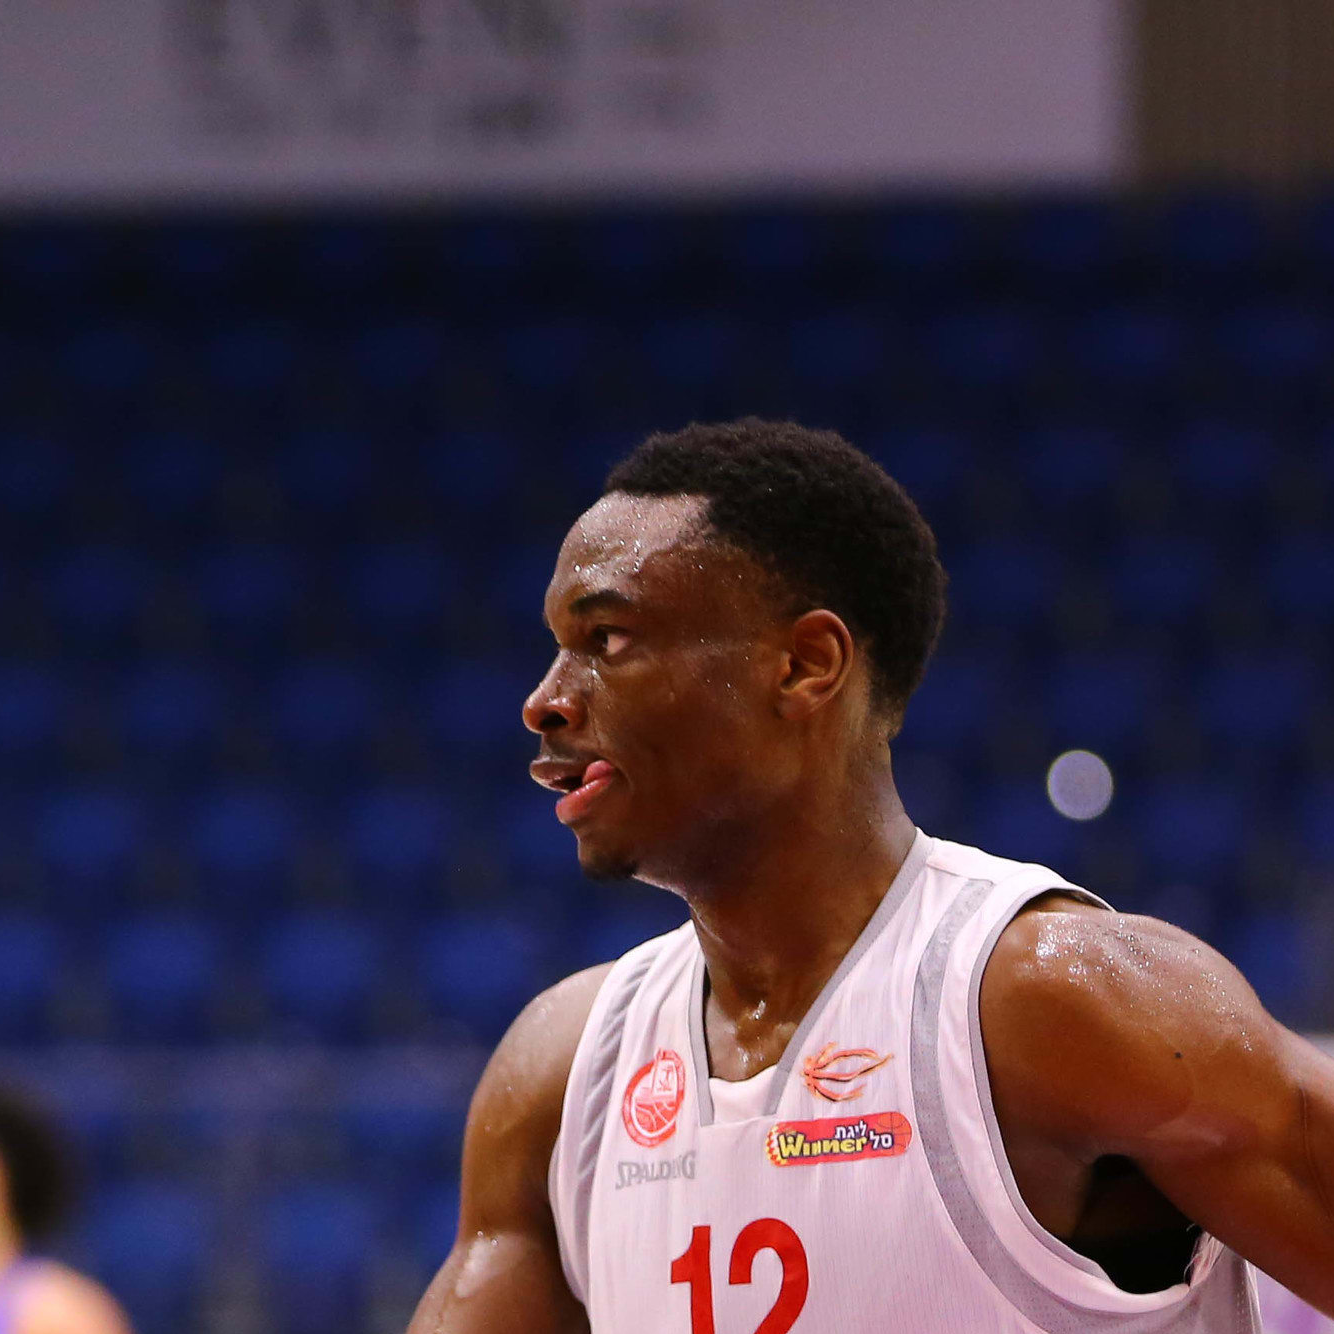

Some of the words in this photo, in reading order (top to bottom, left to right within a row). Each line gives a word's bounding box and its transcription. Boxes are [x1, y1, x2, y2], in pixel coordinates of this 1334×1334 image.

[834, 1119, 867, 1140] ליגת
[869, 1129, 894, 1150] סל
[777, 1132, 869, 1159] Winner
[615, 1149, 697, 1191] SPALDING
